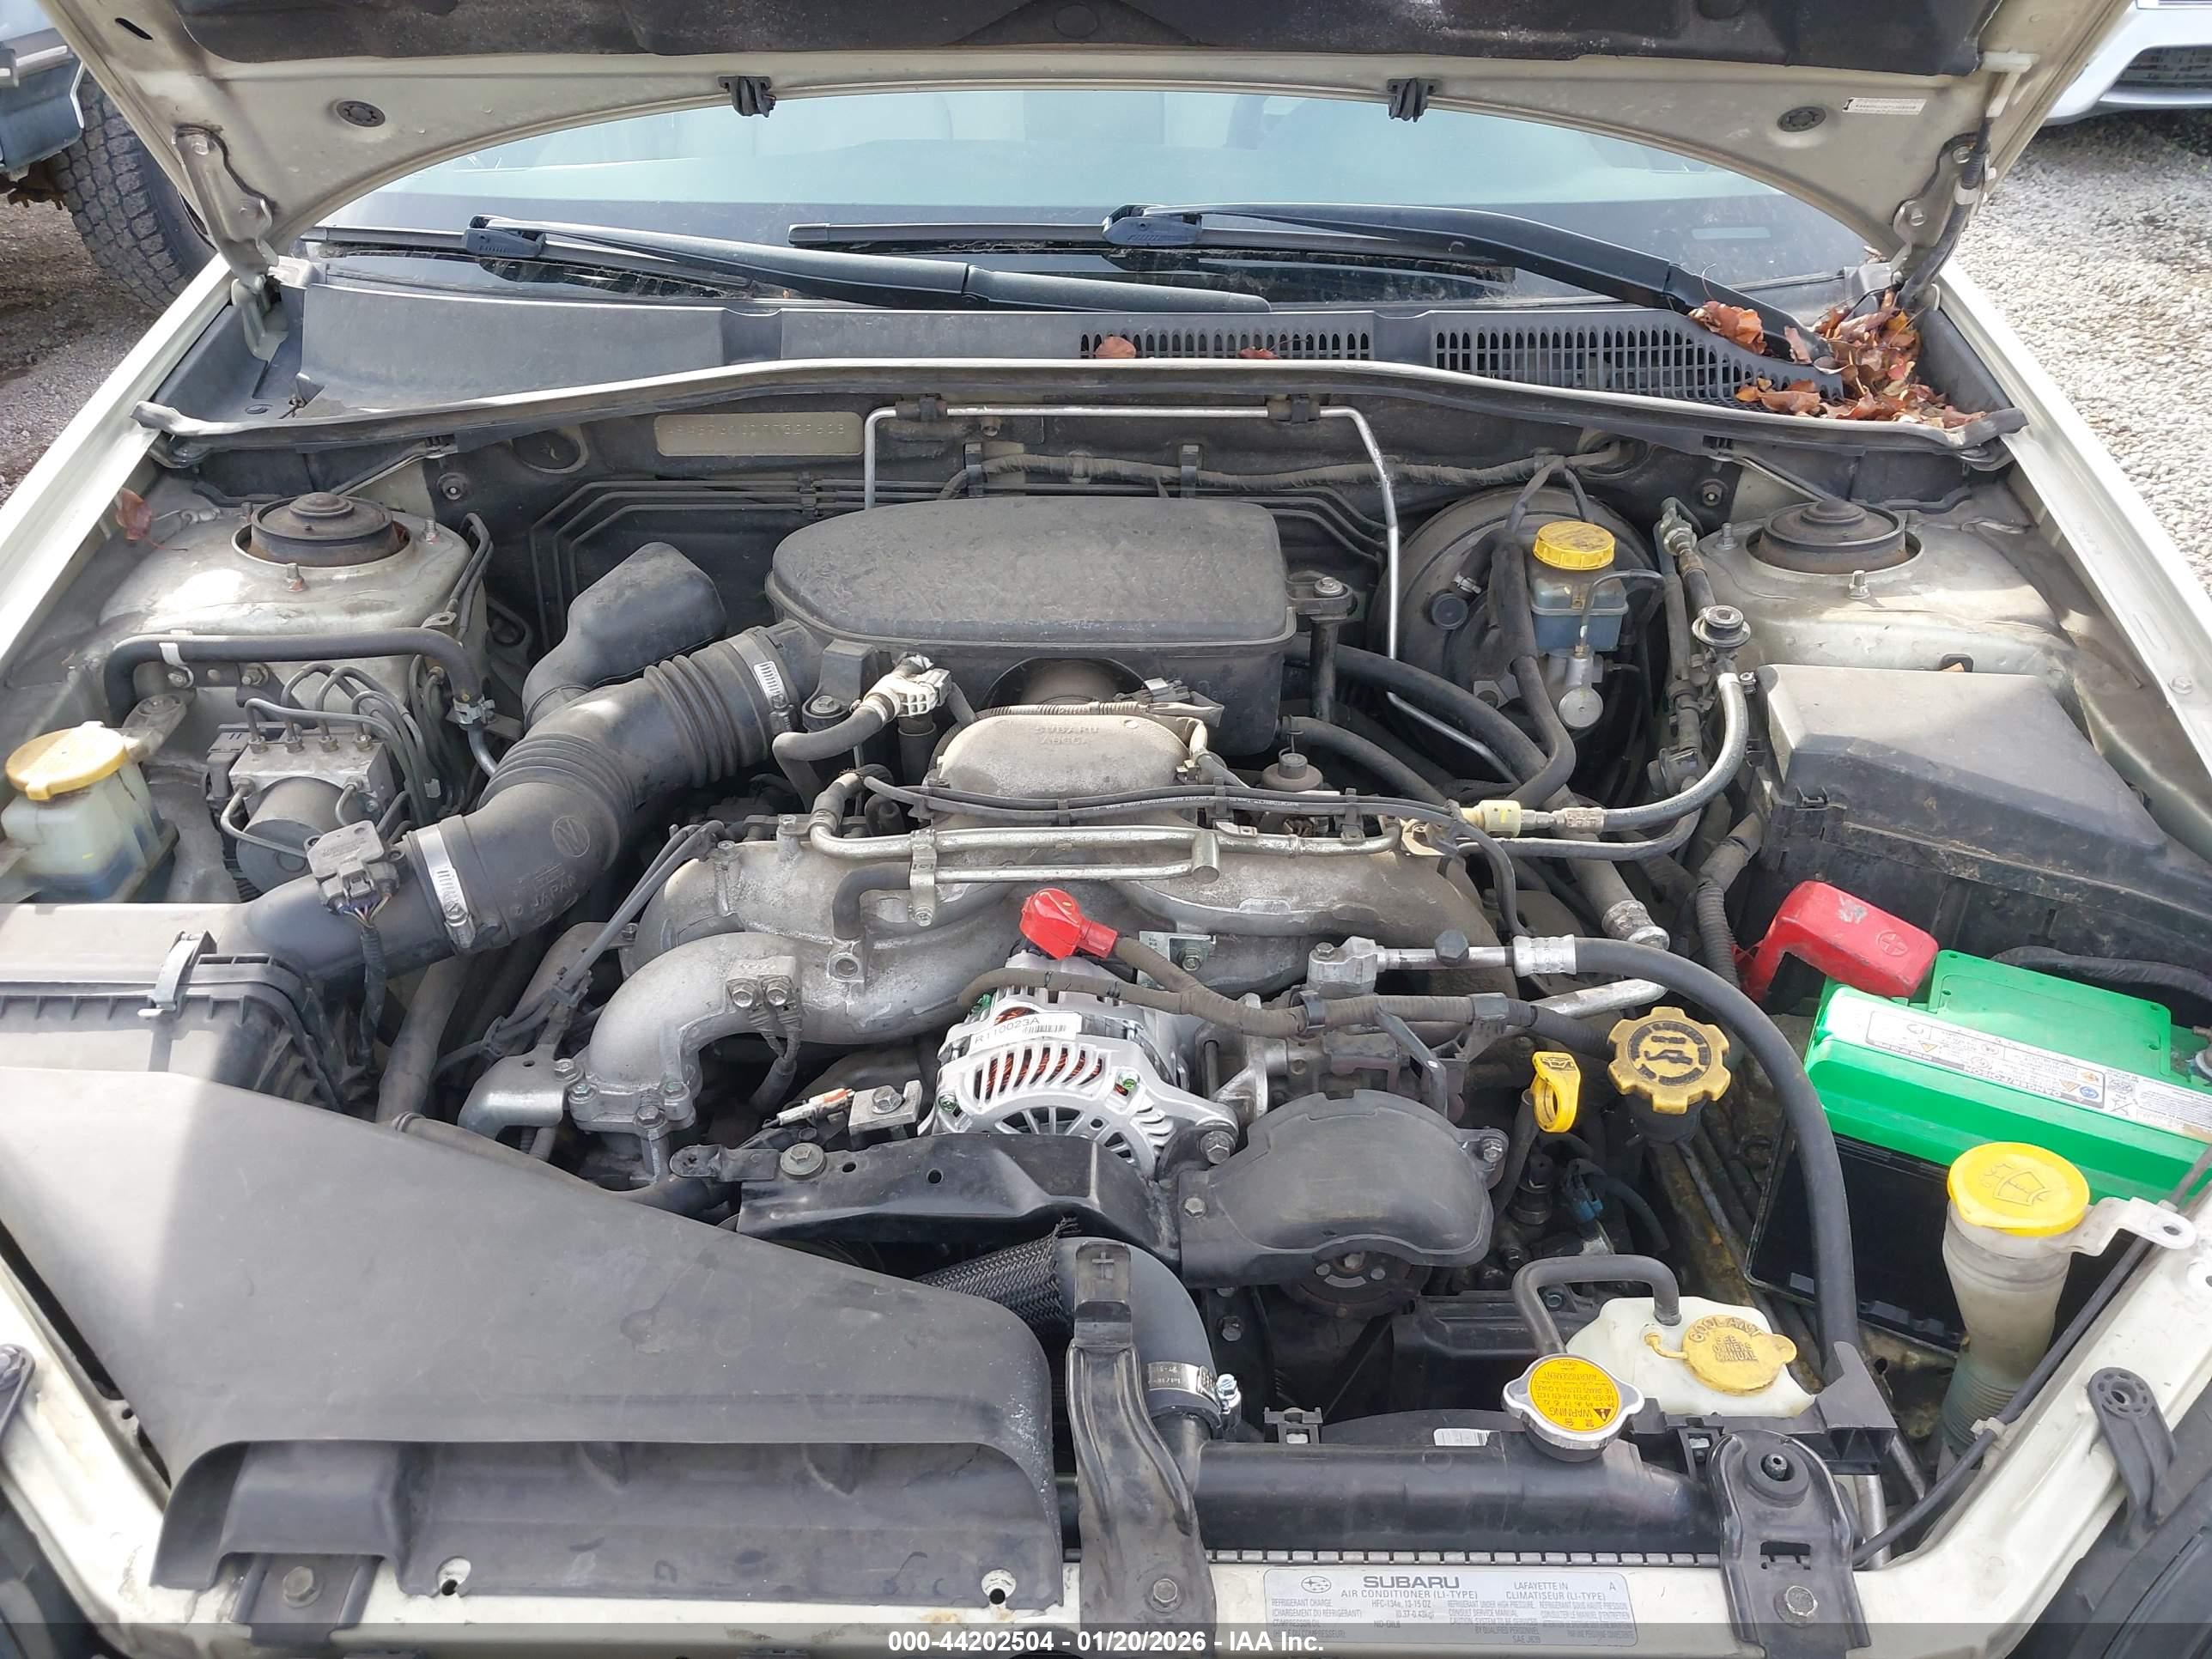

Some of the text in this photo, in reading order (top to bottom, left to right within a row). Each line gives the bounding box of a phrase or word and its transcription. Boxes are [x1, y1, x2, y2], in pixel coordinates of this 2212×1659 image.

[975, 1017, 1040, 1044] R110023A
[1715, 1351, 1758, 1363] MANUAL
[1548, 1407, 1593, 1418] WARNING
[1364, 1576, 1460, 1589] SUBARU
[1514, 1582, 1568, 1590] LAFAYETTE IN
[1608, 1582, 1616, 1590] A
[1340, 1589, 1478, 1600] AIR CONDITIONER (LI-TYPE)
[1505, 1591, 1606, 1601] CLIMATISEUR (LI-TYPE)
